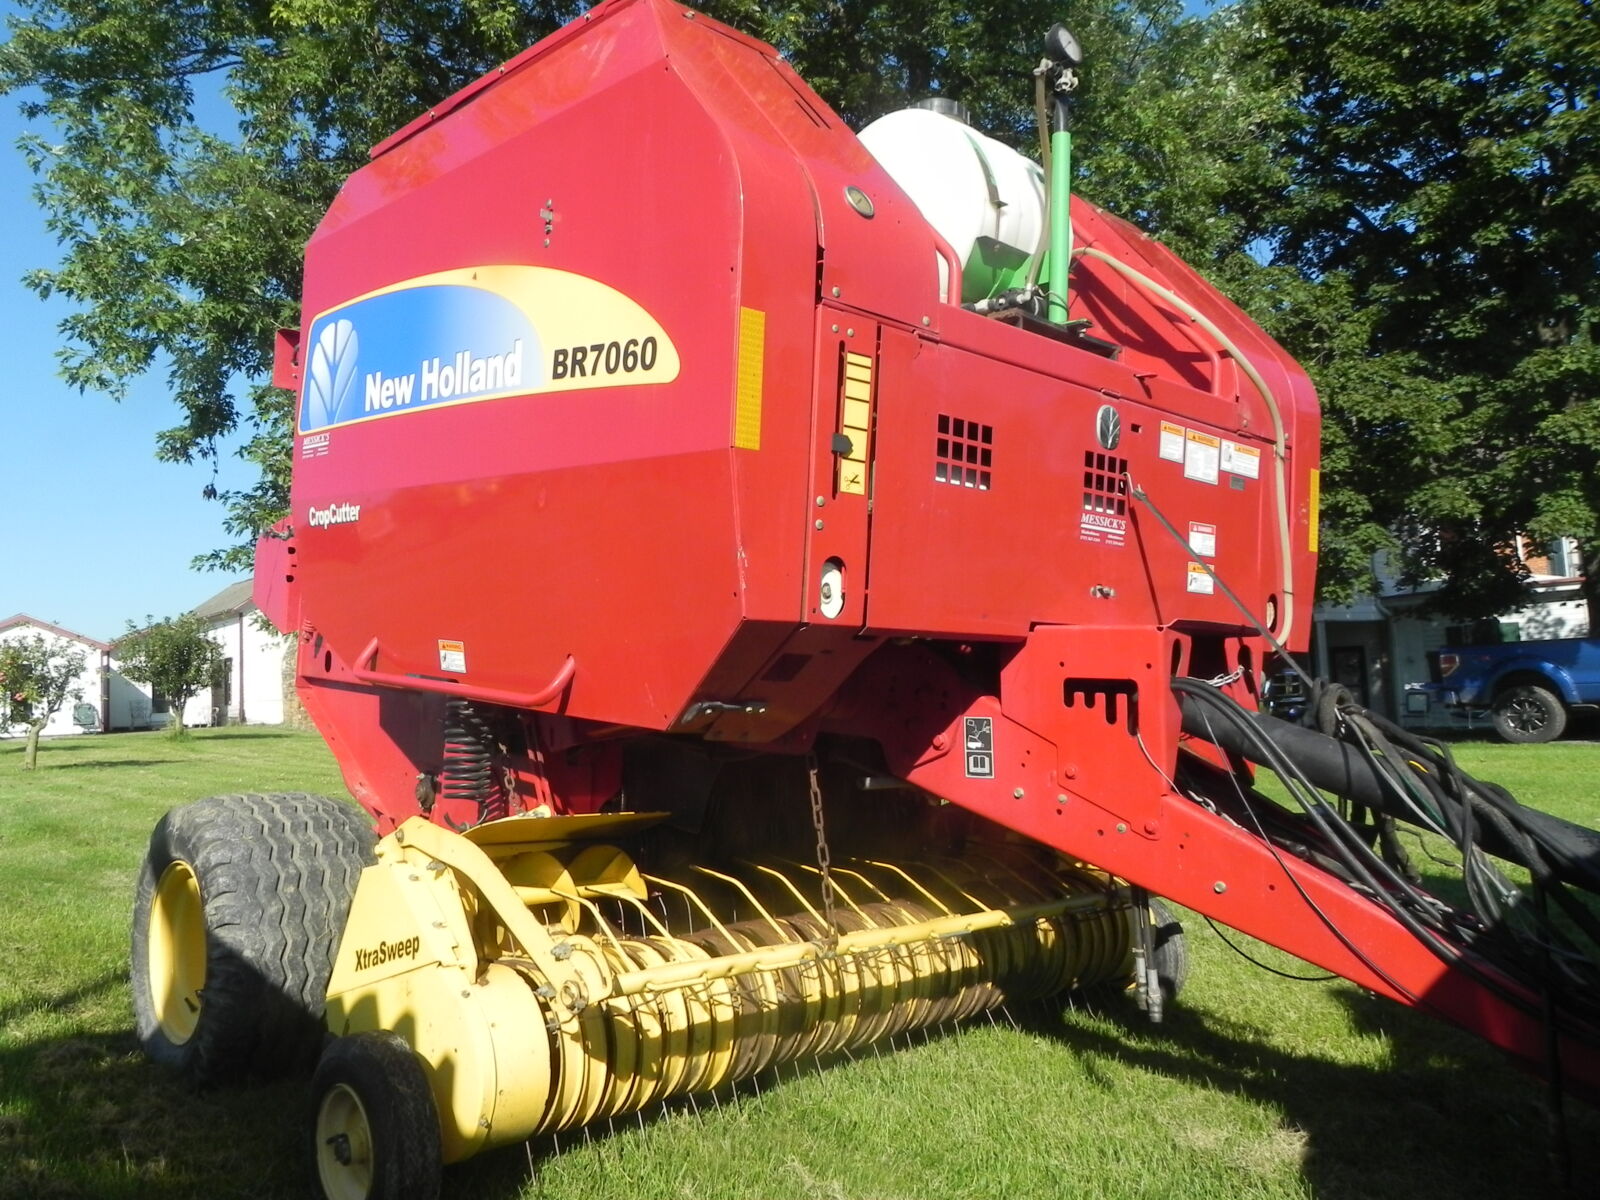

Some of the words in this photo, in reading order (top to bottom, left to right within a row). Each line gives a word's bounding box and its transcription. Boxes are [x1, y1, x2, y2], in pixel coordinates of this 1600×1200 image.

[365, 370, 415, 412] New
[421, 339, 523, 401] Holland
[552, 336, 658, 380] BR7060
[309, 502, 361, 529] CropCutter
[1080, 513, 1127, 530] MESSICK'S
[355, 936, 420, 972] XtraSweep
